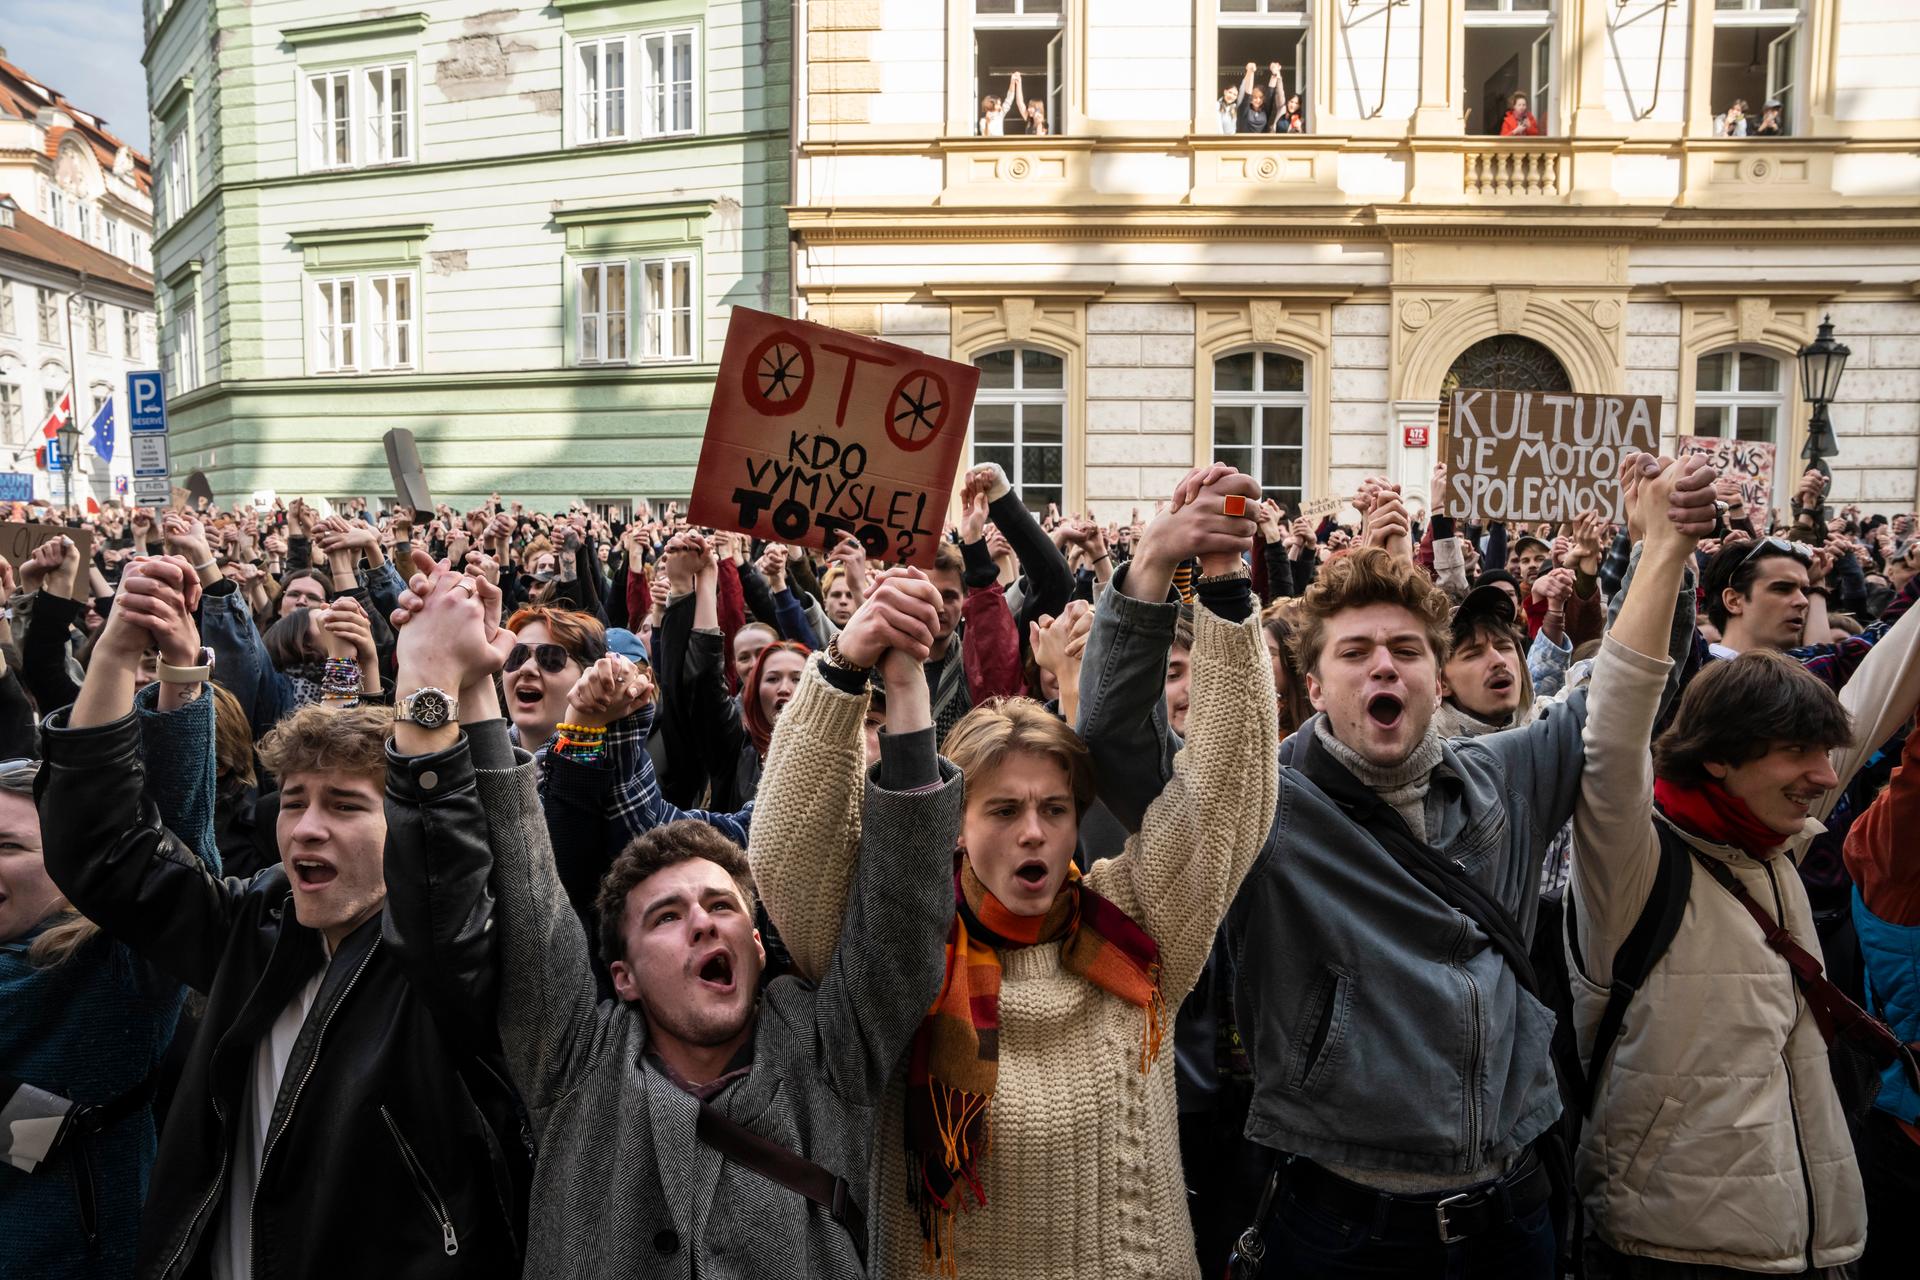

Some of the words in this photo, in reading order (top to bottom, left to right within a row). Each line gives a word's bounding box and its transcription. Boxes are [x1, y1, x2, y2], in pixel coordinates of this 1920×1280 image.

[134, 378, 156, 414] P
[742, 330, 949, 452] OTO
[1409, 428, 1425, 439] 472
[1453, 391, 1657, 448] KULTURA
[788, 430, 867, 480] KDO
[1456, 437, 1498, 475] JE
[746, 457, 934, 536] VYMYSLEL
[731, 487, 917, 565] TOTO?
